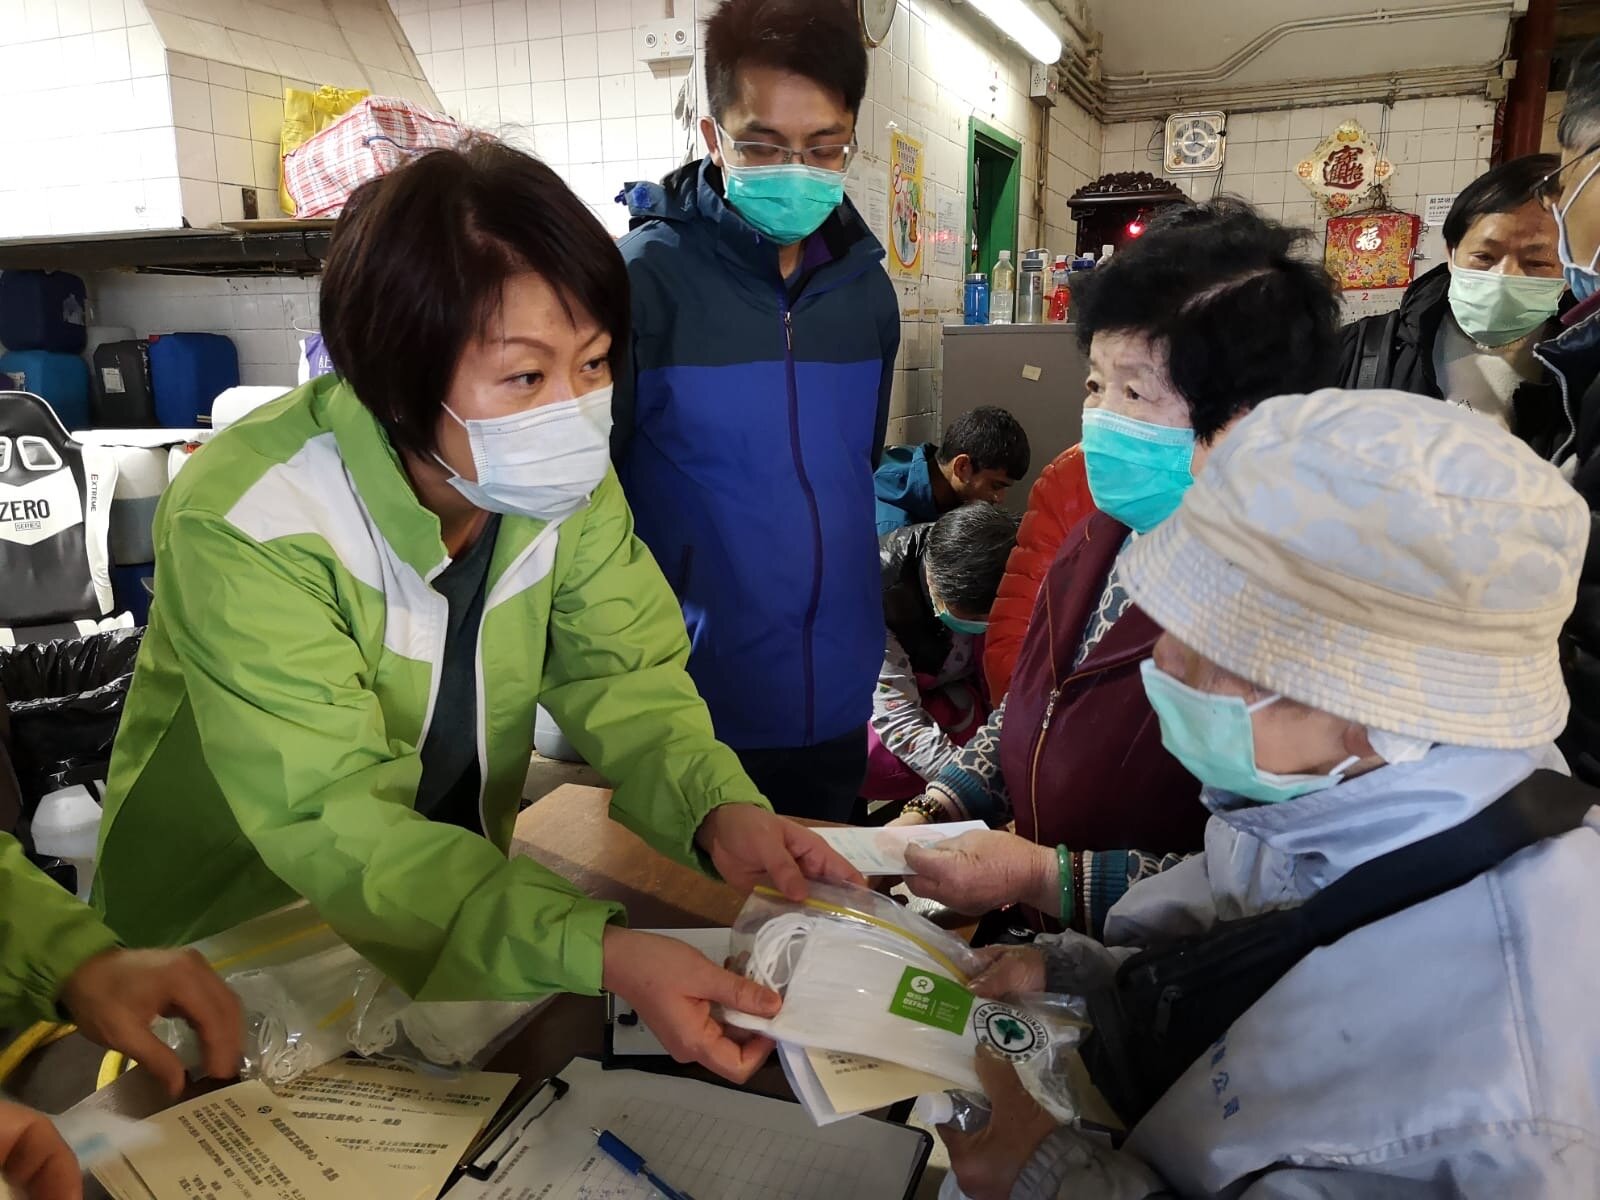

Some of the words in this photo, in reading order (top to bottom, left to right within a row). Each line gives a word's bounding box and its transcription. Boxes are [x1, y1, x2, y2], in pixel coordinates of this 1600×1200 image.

[1355, 226, 1382, 251] 福
[1361, 292, 1369, 301] 2
[91, 473, 99, 512] EXTREME
[0, 499, 50, 522] ZERO
[16, 522, 41, 530] SERIES
